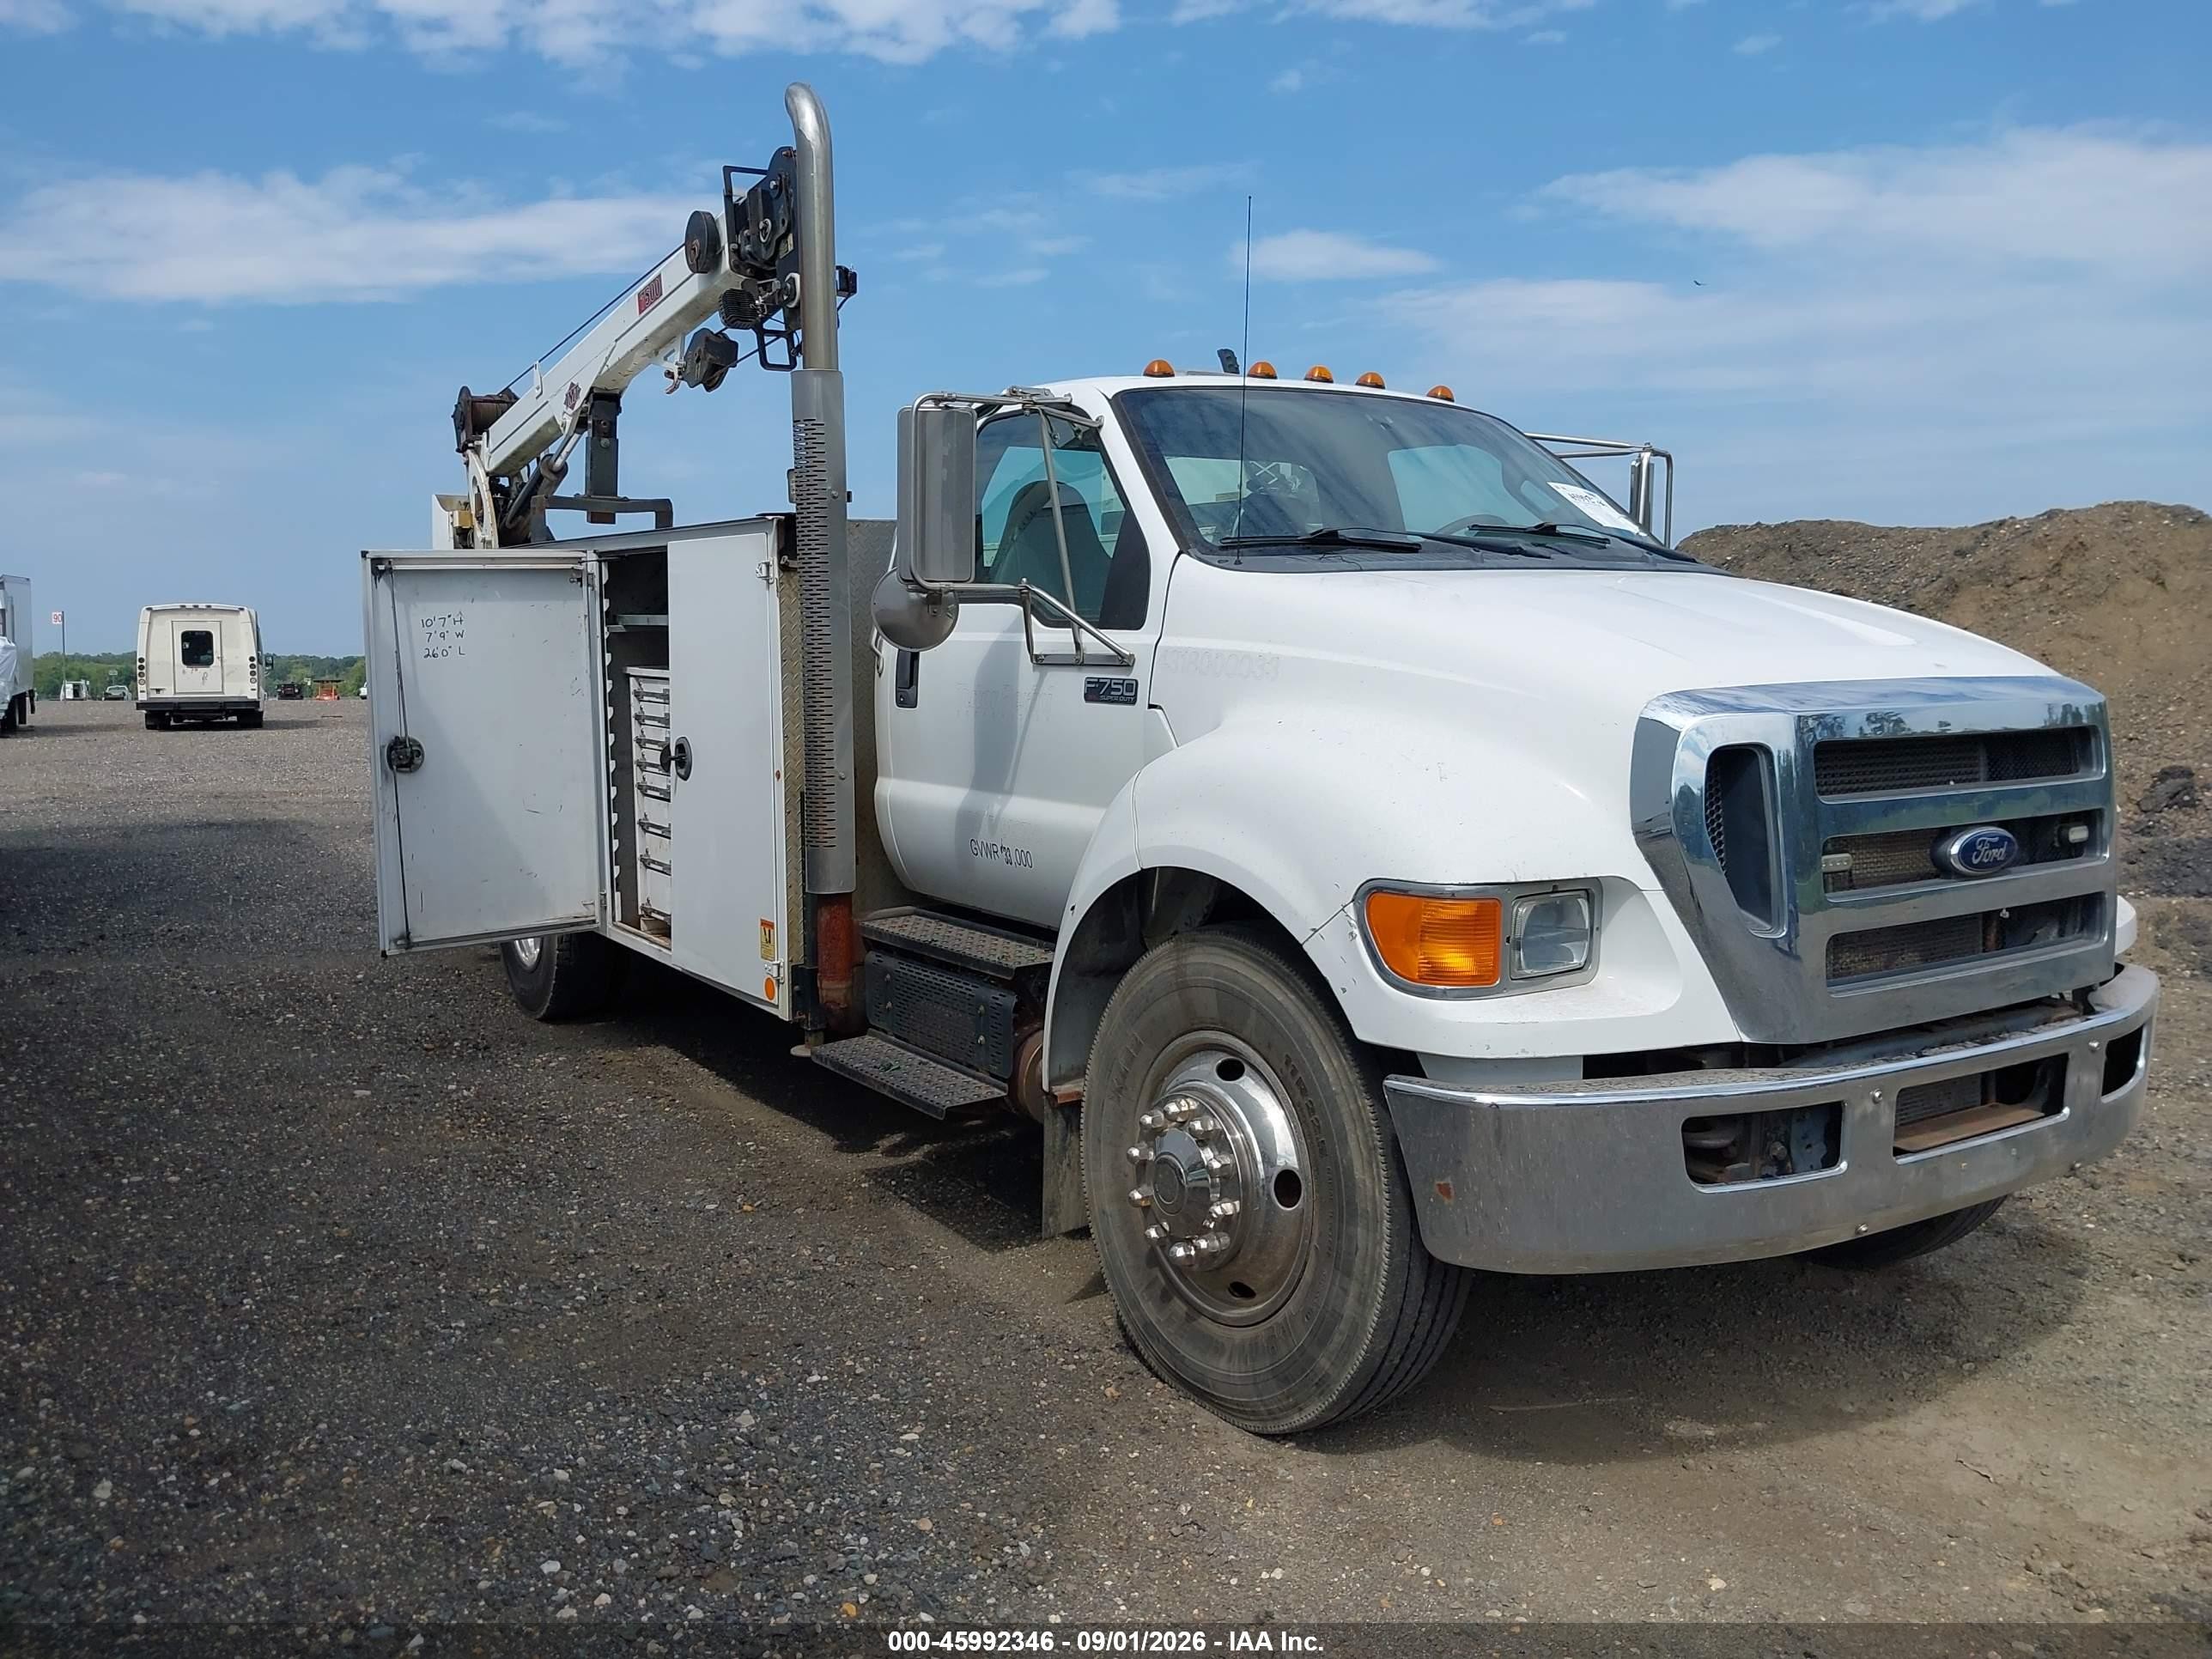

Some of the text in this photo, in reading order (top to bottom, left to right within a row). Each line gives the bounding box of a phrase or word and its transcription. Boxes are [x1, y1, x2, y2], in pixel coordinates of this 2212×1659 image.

[53, 613, 63, 623] 90
[970, 838, 1000, 860] GVWR
[1972, 836, 2008, 864] Ford
